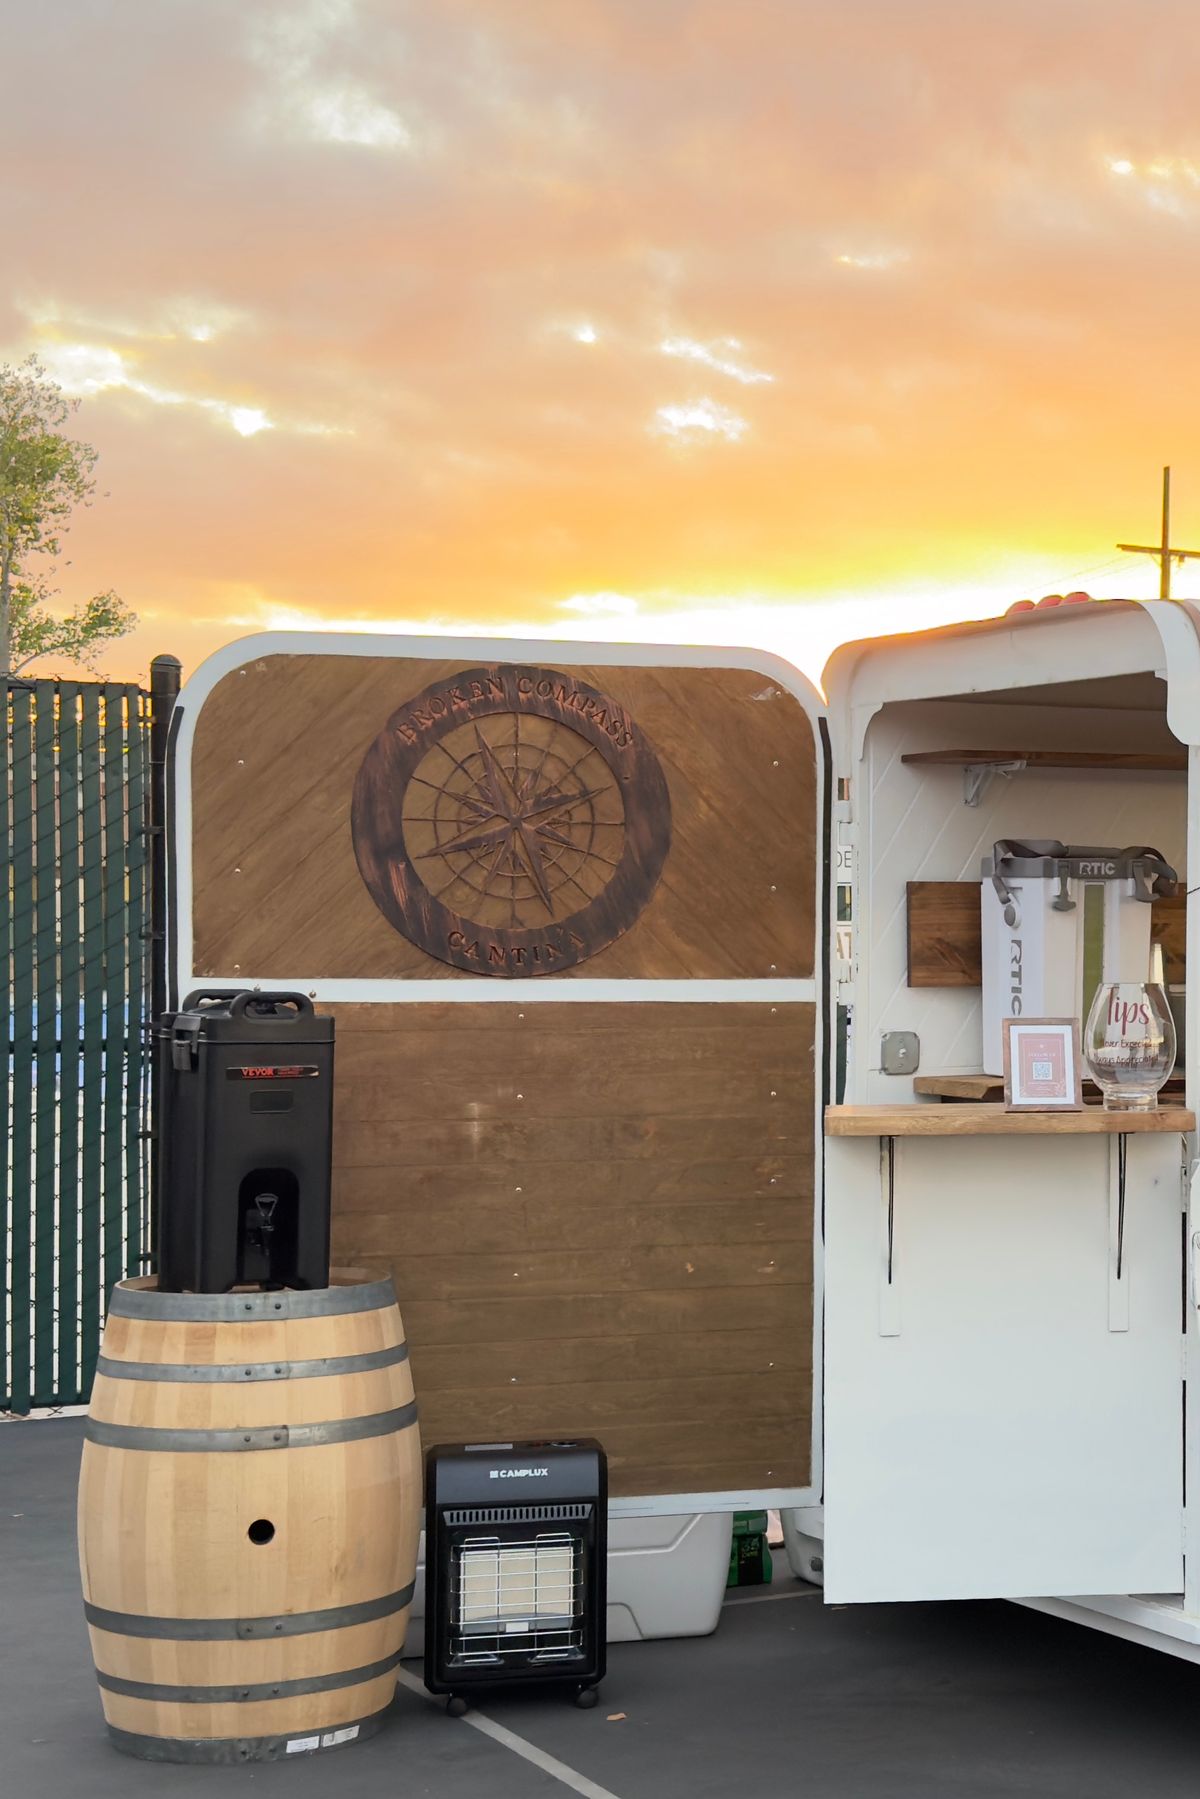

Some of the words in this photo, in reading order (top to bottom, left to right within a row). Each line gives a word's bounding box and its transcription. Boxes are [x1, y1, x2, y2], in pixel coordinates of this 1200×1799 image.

[396, 677, 506, 745] BROKEN
[517, 676, 634, 748] COMPASS
[1079, 861, 1116, 875] RTIC
[448, 931, 584, 966] CANTINA
[1010, 939, 1023, 1016] RTIC
[241, 1066, 274, 1077] VEVOR
[499, 1468, 549, 1479] CAMPLUX
